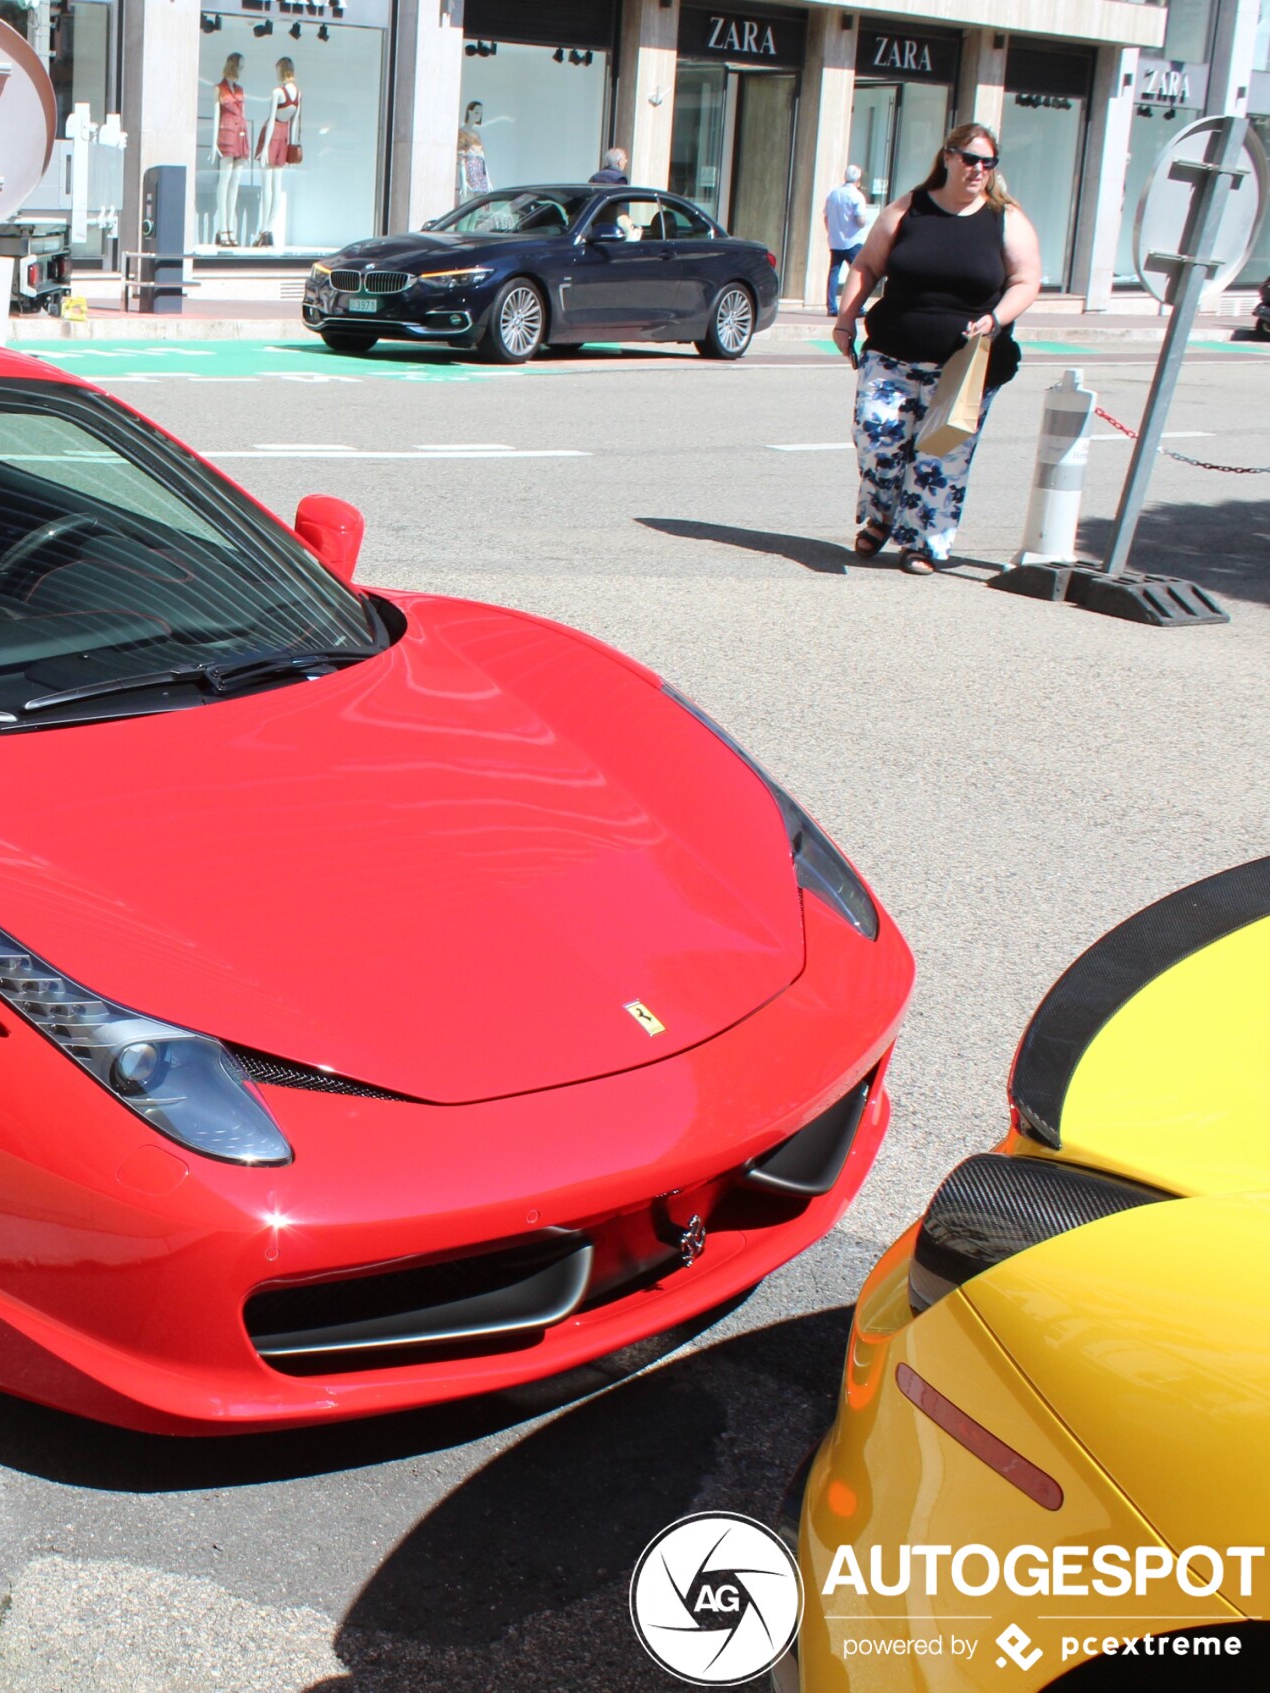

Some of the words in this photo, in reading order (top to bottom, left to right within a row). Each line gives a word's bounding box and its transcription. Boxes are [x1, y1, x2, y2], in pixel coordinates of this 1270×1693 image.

[707, 16, 777, 55] ZARA
[873, 36, 933, 72] ZARA
[1144, 69, 1190, 98] ZARA
